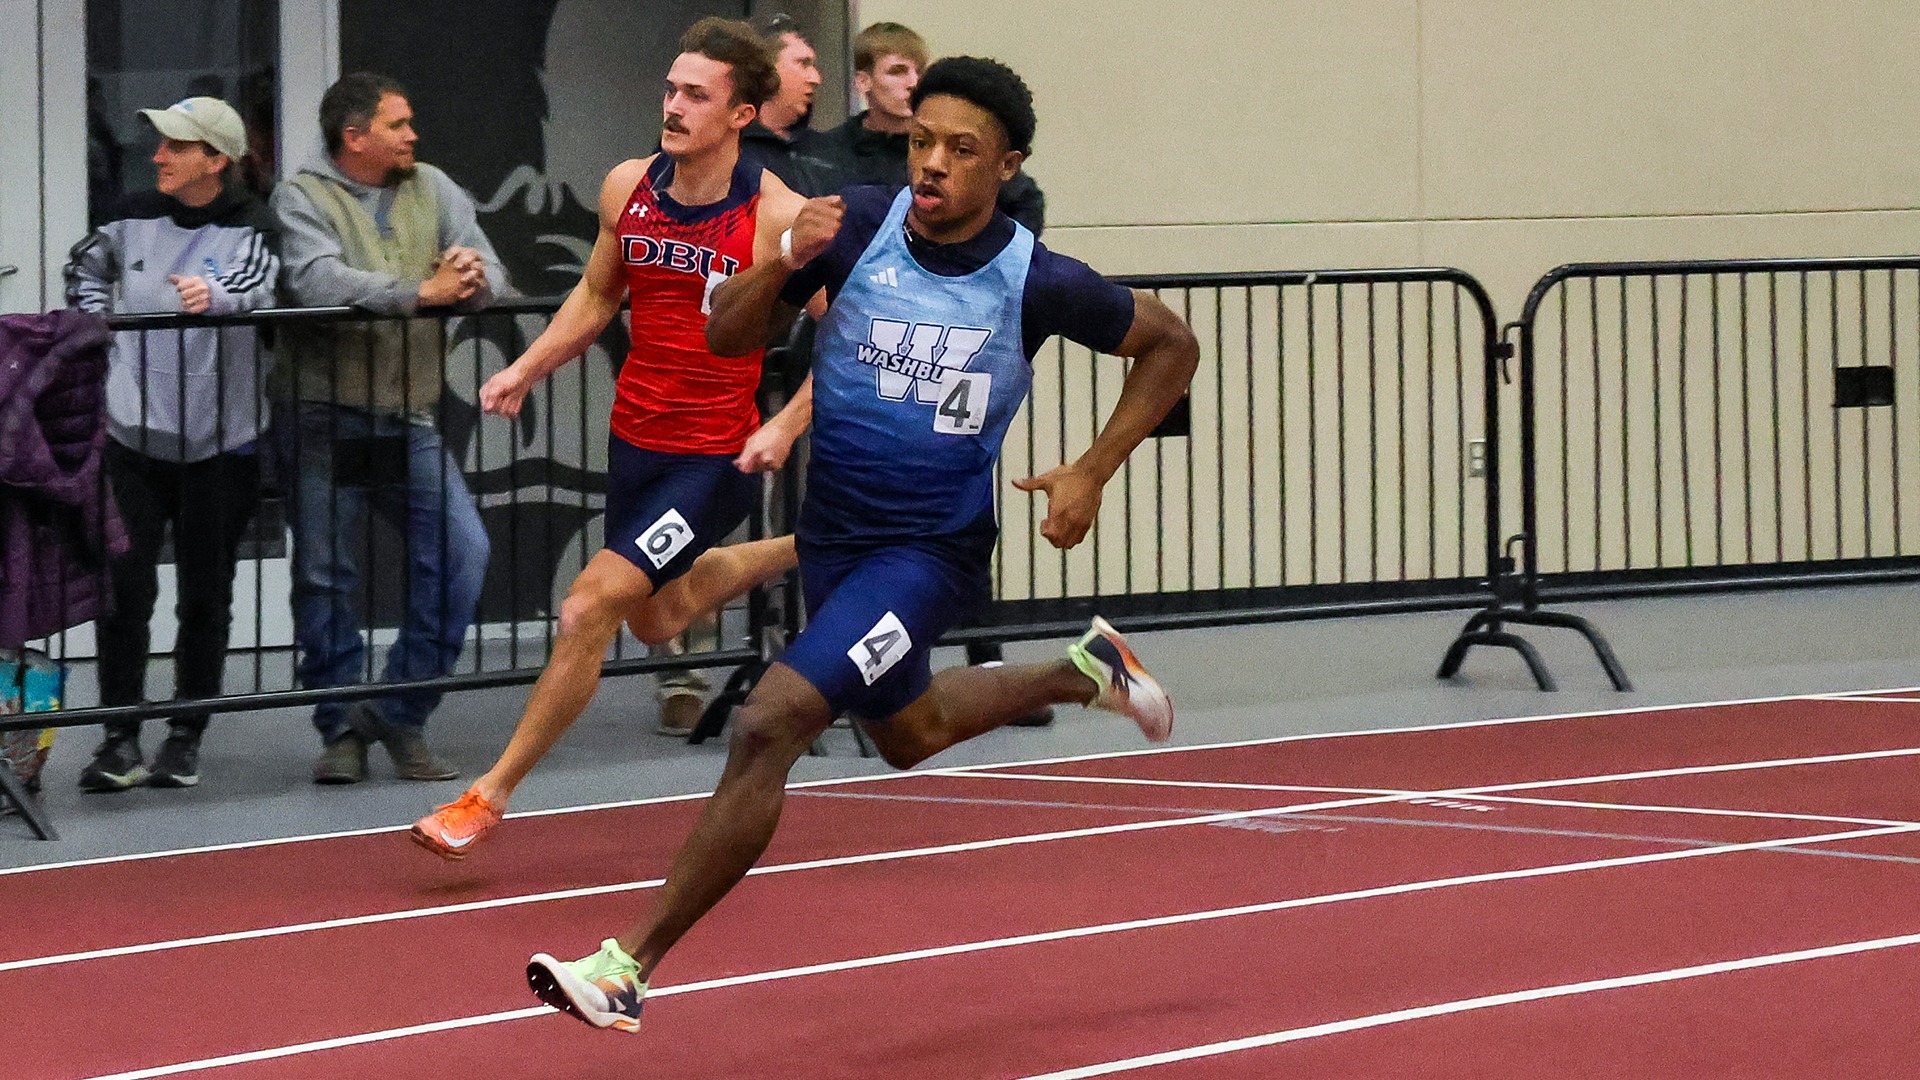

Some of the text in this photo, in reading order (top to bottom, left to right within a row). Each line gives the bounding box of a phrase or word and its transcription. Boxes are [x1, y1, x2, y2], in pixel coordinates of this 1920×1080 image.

[621, 235, 739, 280] DBU
[857, 343, 944, 385] WASHBU
[869, 317, 993, 404] W
[939, 379, 972, 428] 4
[646, 522, 684, 555] 6
[863, 629, 902, 670] 4
